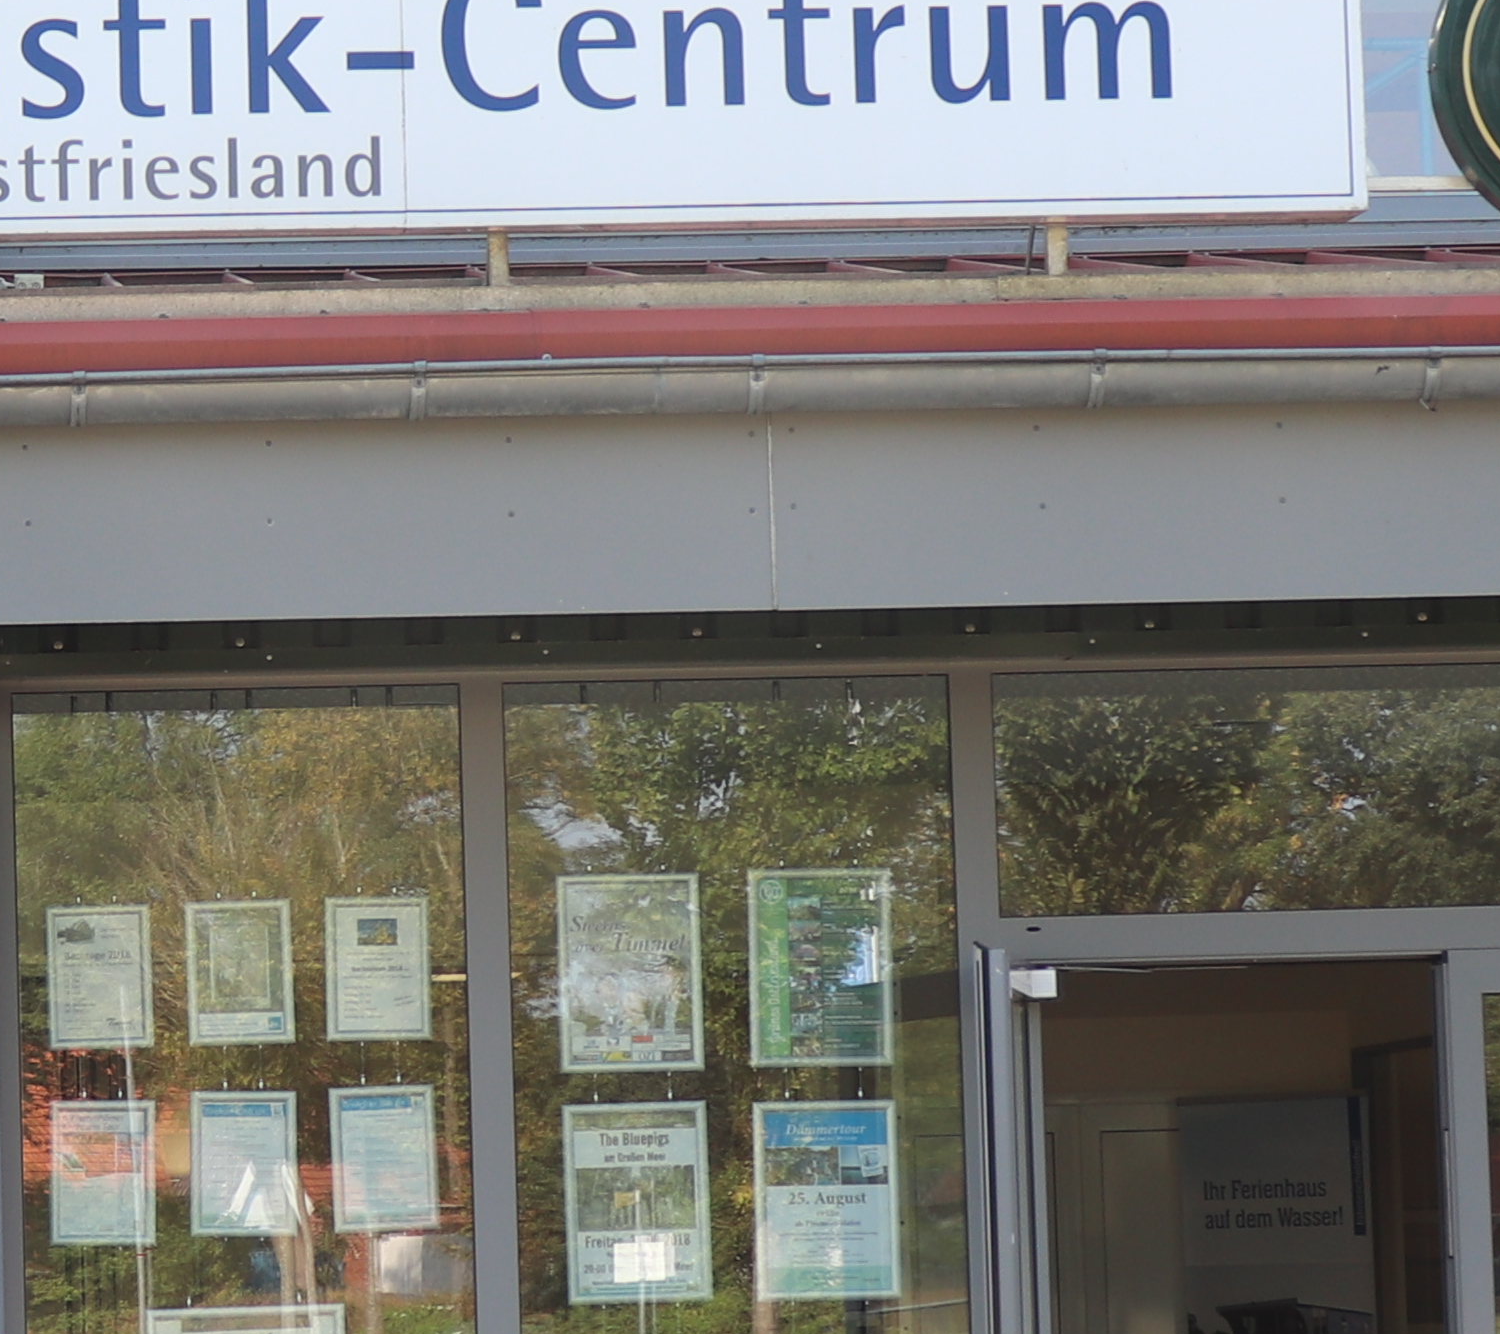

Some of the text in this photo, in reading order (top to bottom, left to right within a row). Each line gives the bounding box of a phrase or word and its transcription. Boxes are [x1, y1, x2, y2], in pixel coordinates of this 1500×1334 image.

[612, 931, 687, 952] Timmel
[599, 1130, 670, 1148] The Bluepigs
[785, 1123, 867, 1136] Dämmertour
[1203, 1178, 1327, 1201] Ihr Ferienhaus
[788, 1191, 867, 1208] 25. August
[1205, 1205, 1344, 1229] auf dem Wasser!
